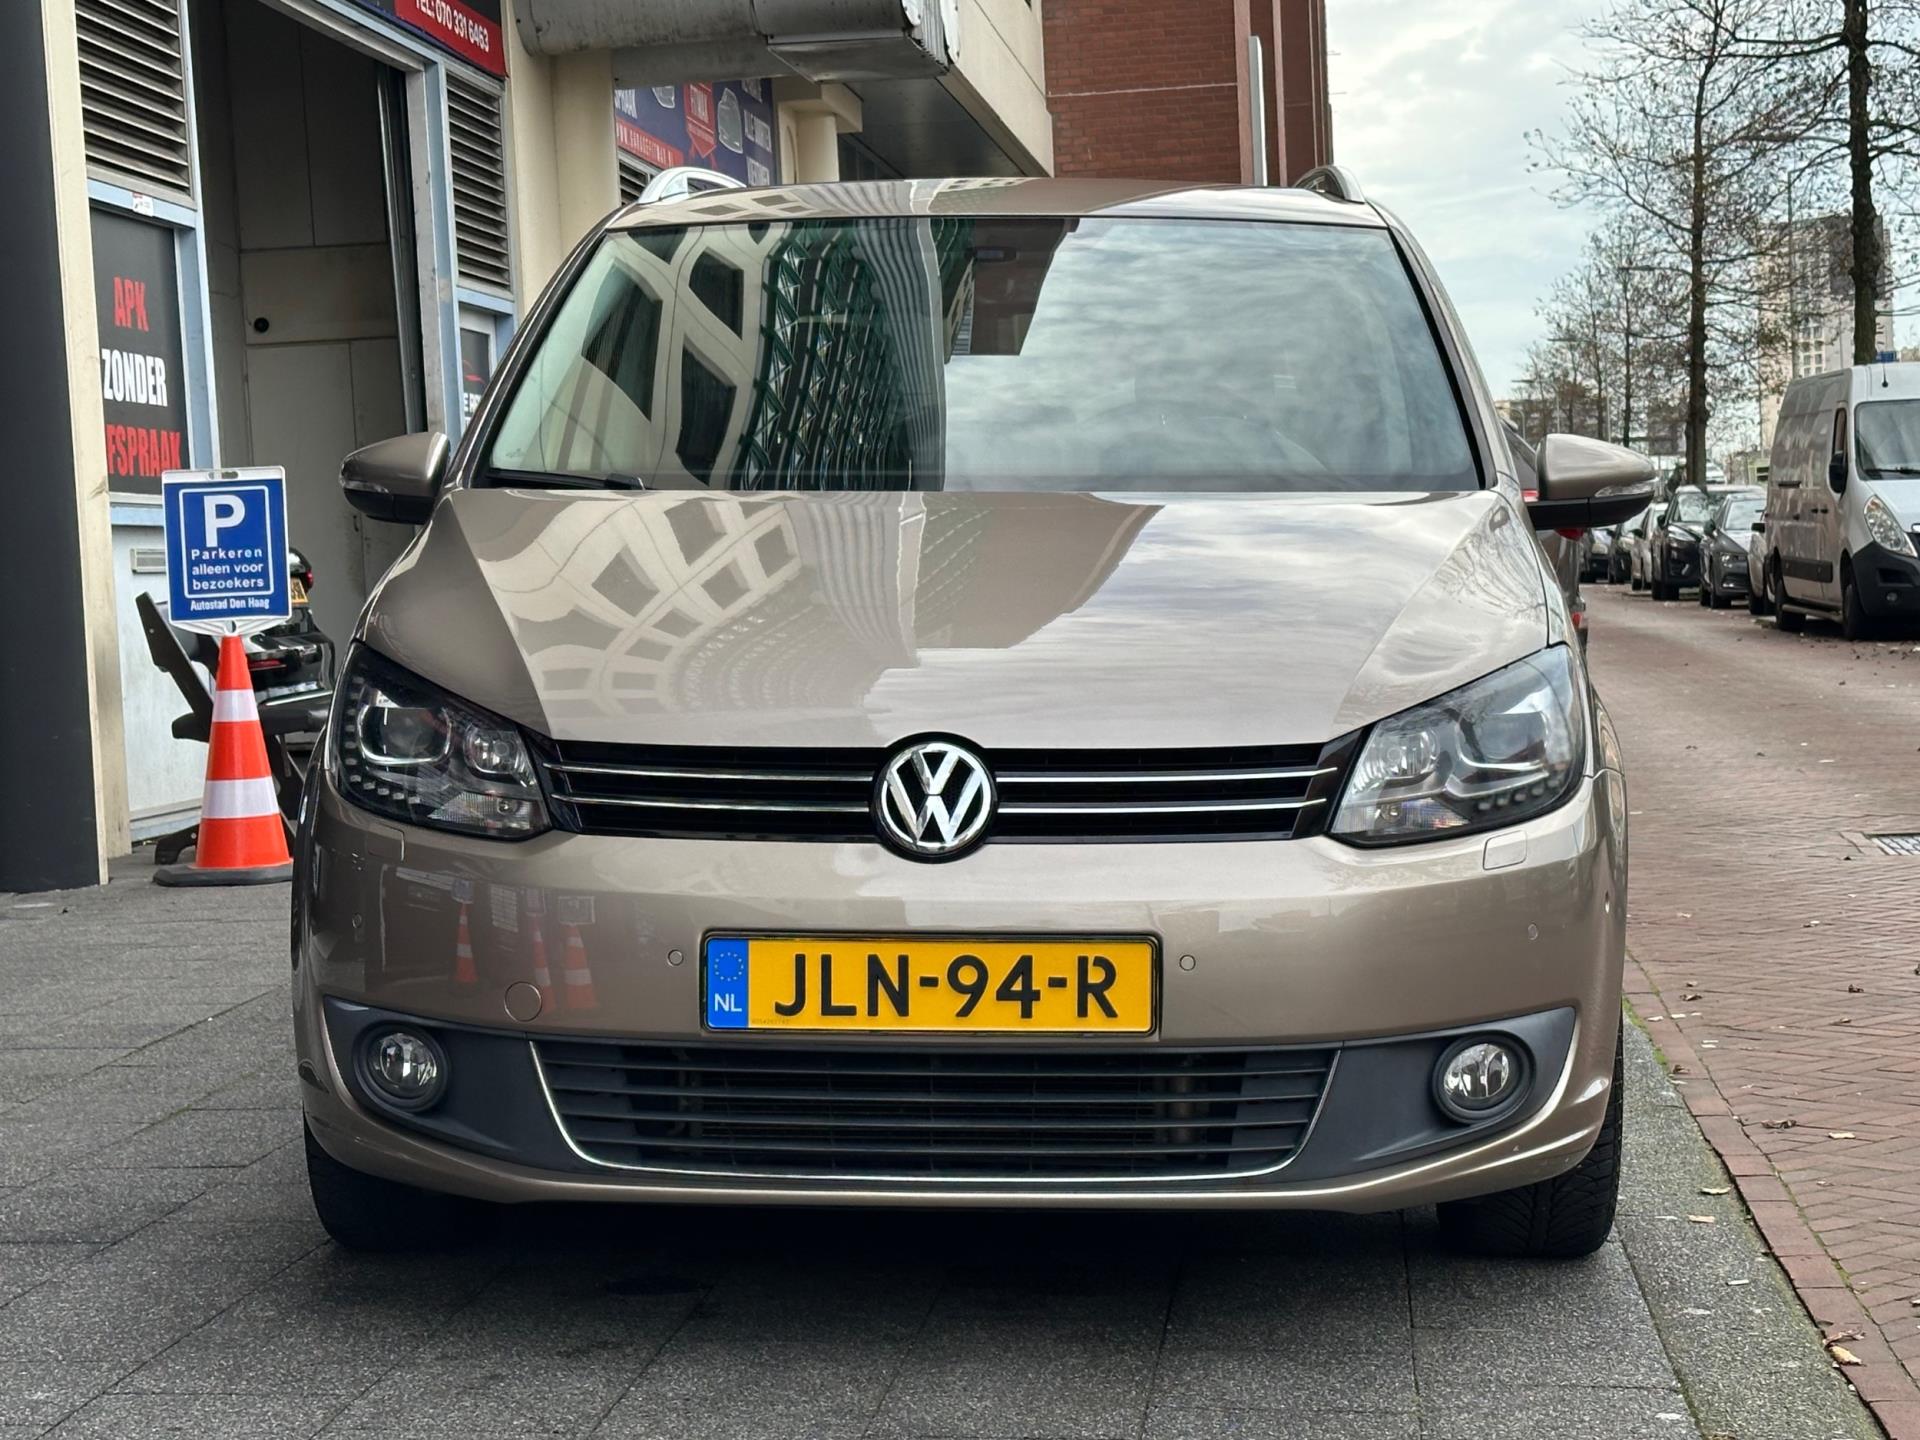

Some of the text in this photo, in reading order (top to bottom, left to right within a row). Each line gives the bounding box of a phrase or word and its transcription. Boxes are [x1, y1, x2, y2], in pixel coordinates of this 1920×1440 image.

[436, 0, 453, 30] 070
[453, 9, 468, 39] 331
[114, 277, 149, 332] APK
[101, 348, 168, 407] ZONDER
[106, 423, 182, 477] FSPRAAK
[203, 494, 246, 548] P
[191, 548, 263, 561] Parkeren
[192, 562, 264, 576] alleen voor
[192, 577, 265, 590] bezoekers
[190, 597, 270, 612] Autostad Den Haag
[714, 993, 743, 1013] NL
[774, 953, 1119, 1019] JLN-94-R
